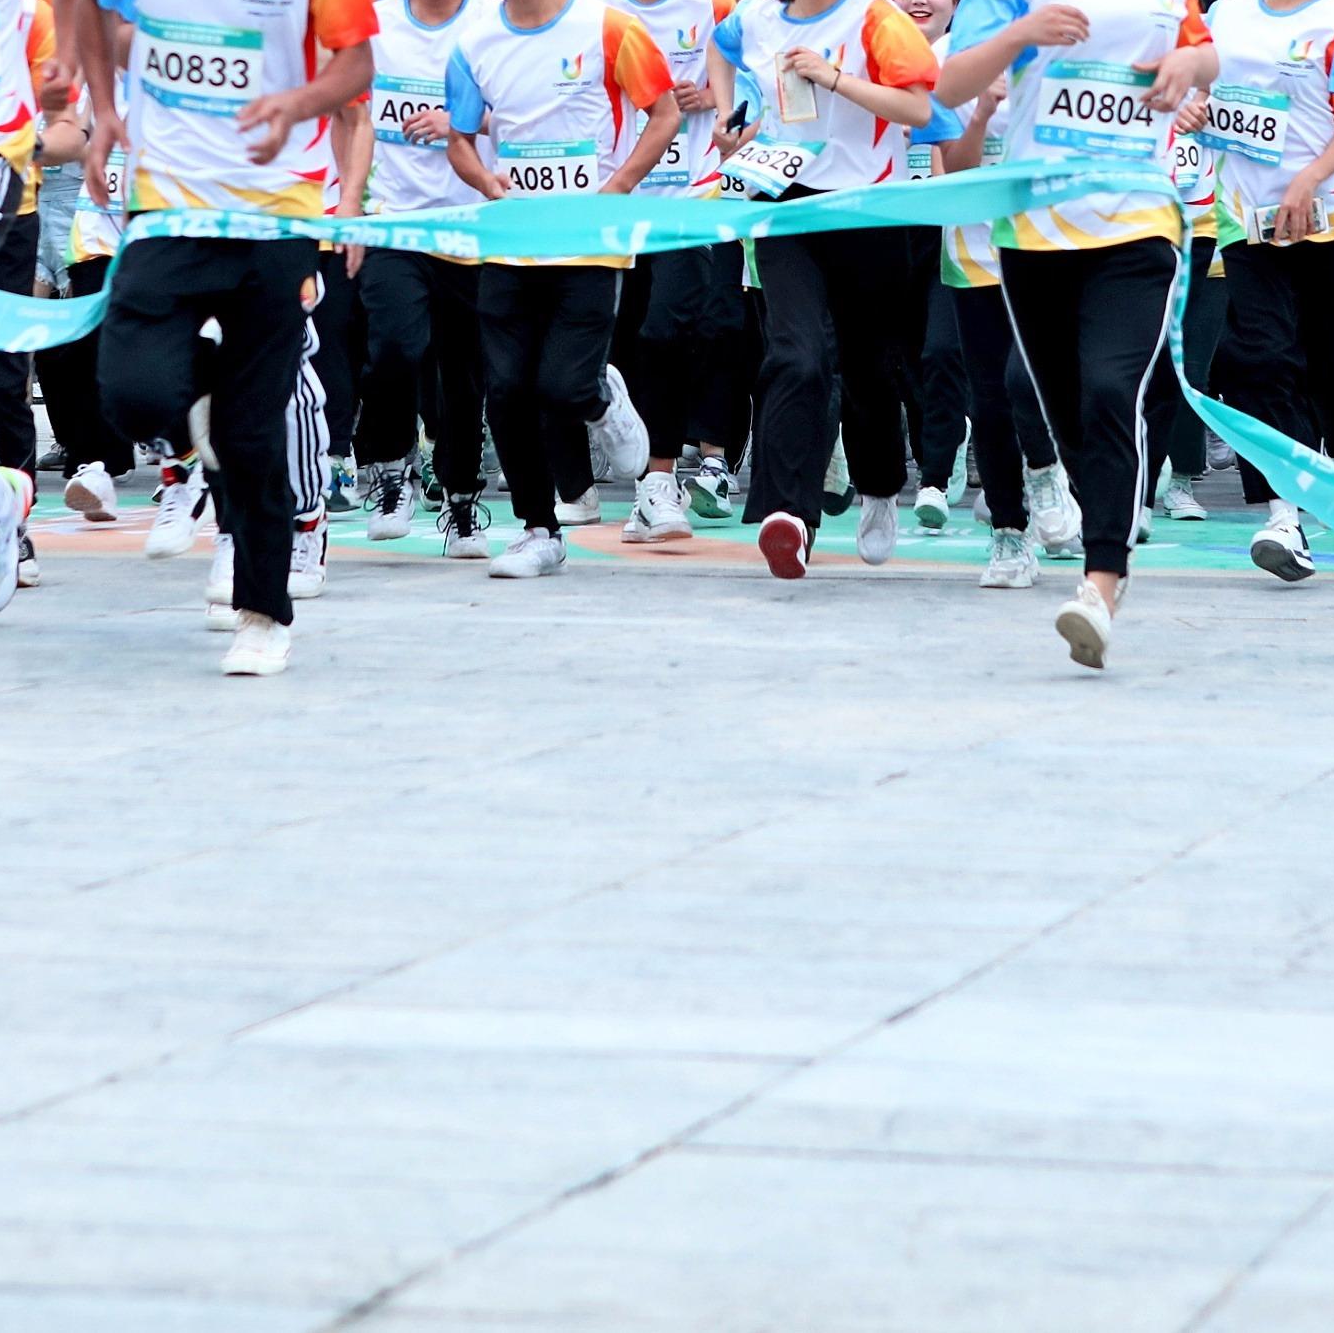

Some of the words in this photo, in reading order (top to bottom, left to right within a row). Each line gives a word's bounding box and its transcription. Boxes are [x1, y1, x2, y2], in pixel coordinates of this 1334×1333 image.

[146, 48, 249, 89] A0833
[1049, 88, 1154, 127] A0804
[1206, 103, 1277, 142] A0848
[666, 142, 681, 164] 5
[736, 145, 804, 179] A0828
[507, 164, 589, 191] A0816
